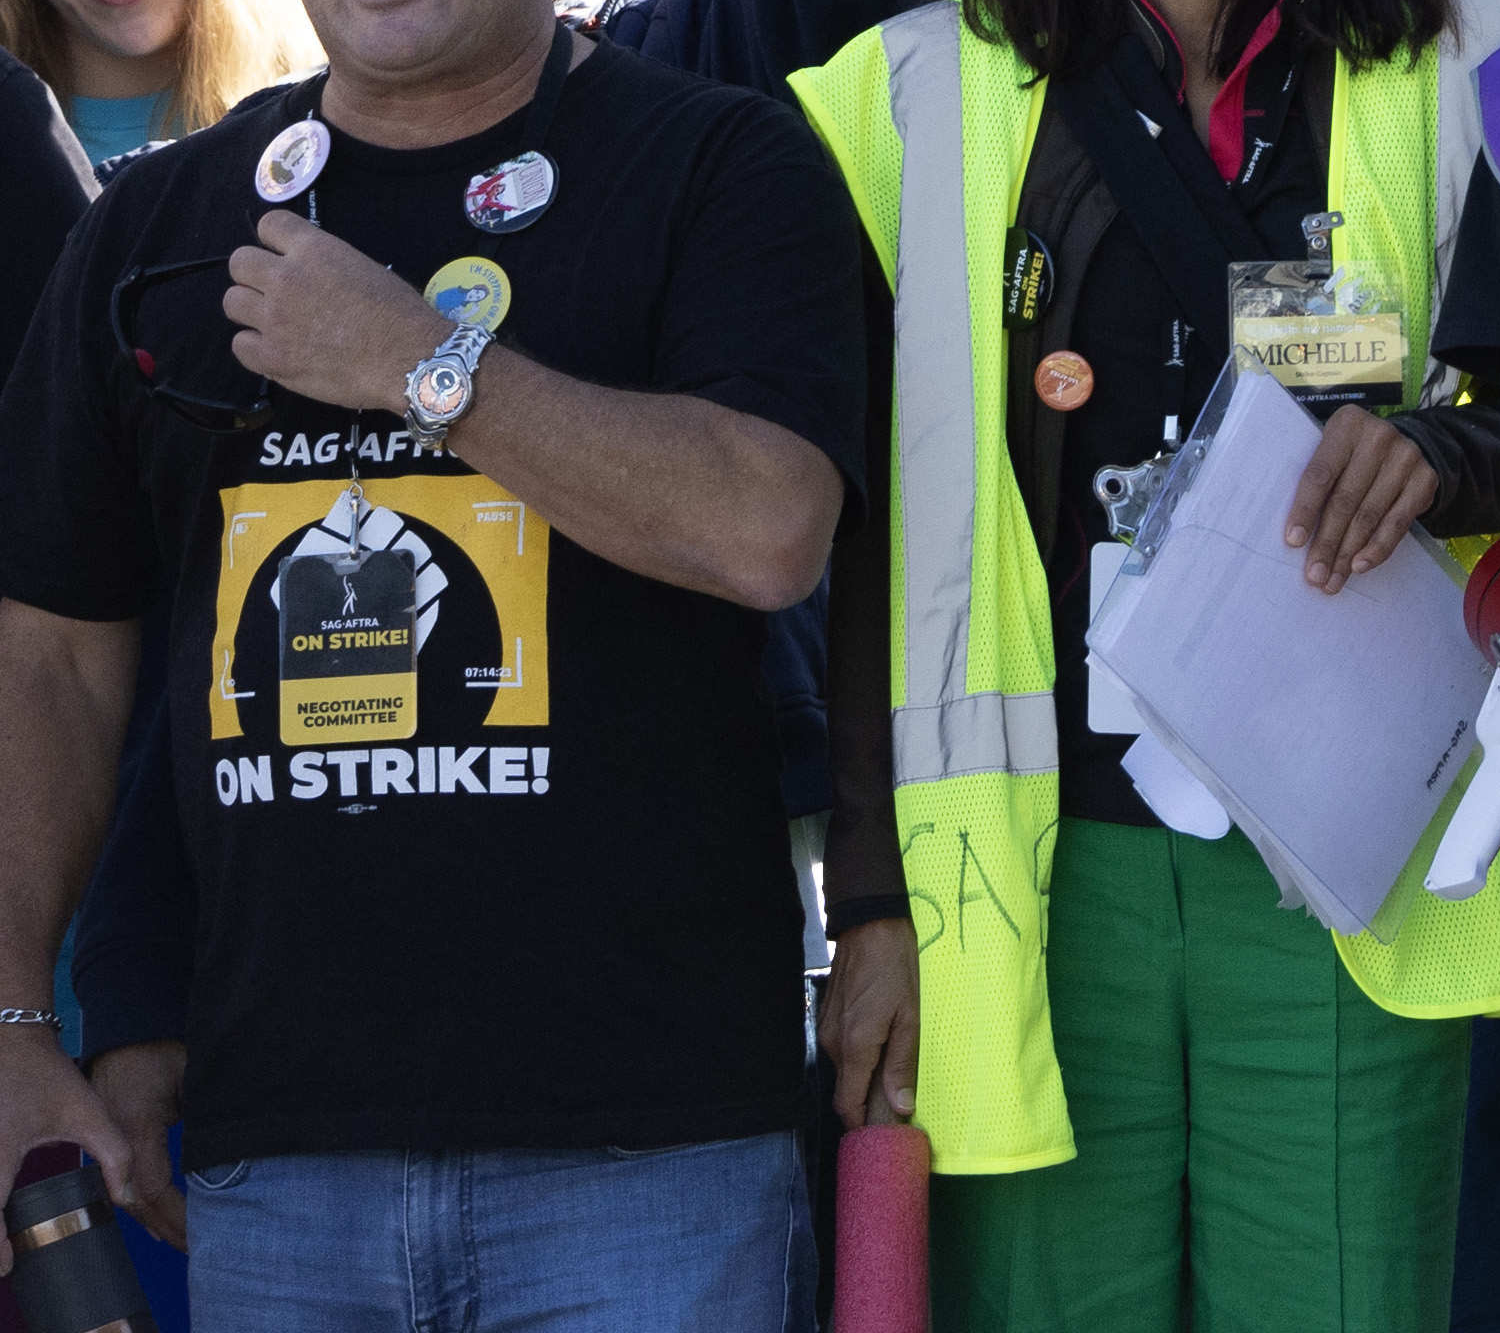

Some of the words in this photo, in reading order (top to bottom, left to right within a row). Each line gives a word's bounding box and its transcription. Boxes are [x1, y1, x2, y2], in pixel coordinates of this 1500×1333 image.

[1022, 251, 1045, 320] STRIKE!
[1252, 339, 1387, 366] MICHELLE
[476, 511, 514, 523] PAUSE
[292, 635, 325, 653] ON
[329, 629, 409, 650] STRIKE!
[297, 696, 404, 715] NEGOTIATING
[303, 711, 398, 728] COMMITTEE
[215, 755, 275, 807] ON
[289, 746, 550, 800] STRIKE!
